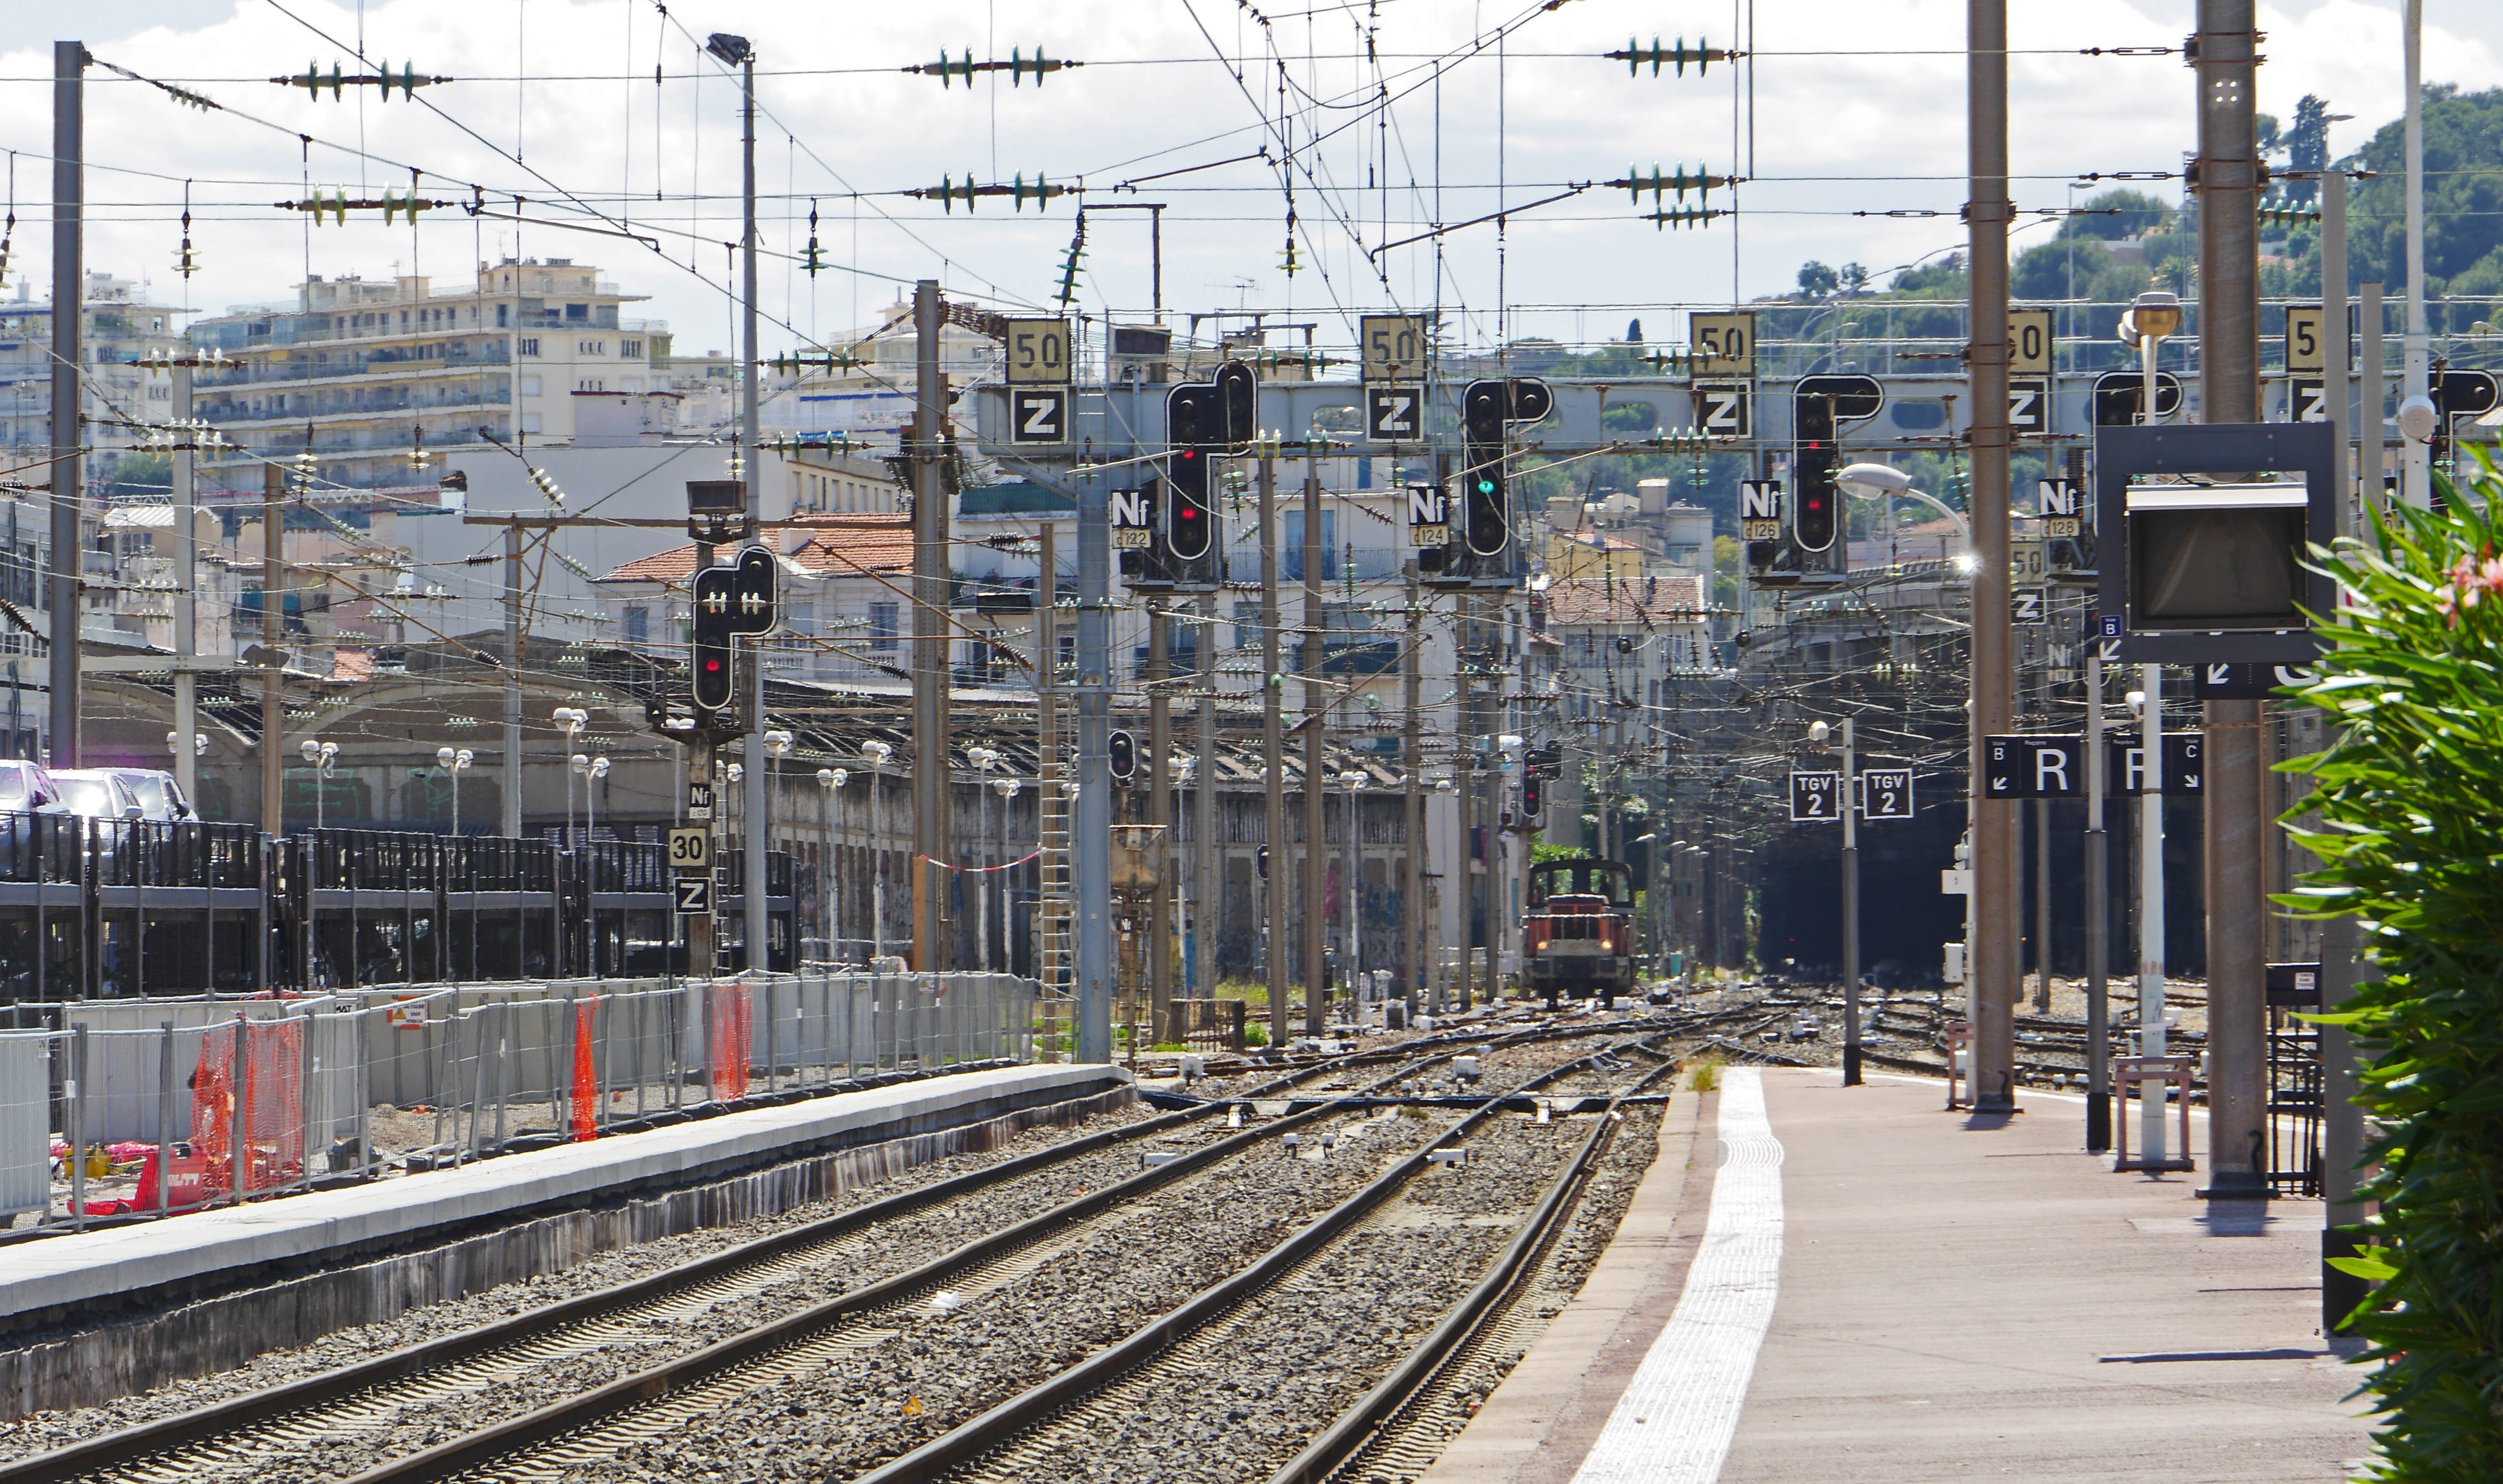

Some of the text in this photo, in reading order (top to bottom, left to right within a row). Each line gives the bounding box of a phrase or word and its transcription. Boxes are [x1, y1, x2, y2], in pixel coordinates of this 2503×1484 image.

[1017, 334, 1059, 368] 50
[1372, 331, 1414, 365] 50
[1701, 328, 1743, 362] 50
[1024, 399, 1055, 433] Z
[1380, 397, 1411, 430] Z
[1707, 394, 1737, 428] Z
[2010, 390, 2035, 424] Z
[2301, 388, 2325, 420] Z
[1112, 492, 1149, 525] Nf
[1408, 489, 1445, 523] Nf
[1743, 484, 1779, 517] Nf
[2040, 482, 2077, 514] Nf
[1422, 529, 1443, 542] 124
[1755, 524, 1775, 536] 126
[2053, 521, 2074, 534] 128
[2013, 551, 2040, 574] 50
[2017, 595, 2038, 617] Z
[2106, 624, 2115, 634] B
[1994, 748, 2004, 760] B
[2186, 745, 2197, 758] C
[1871, 775, 1904, 789] TGV
[2036, 749, 2068, 790] R
[691, 787, 710, 804] Nf
[1798, 777, 1831, 791] TGV
[1808, 794, 1822, 815] 2
[1882, 792, 1895, 813] 2
[673, 835, 702, 860] 30
[680, 883, 705, 908] Z
